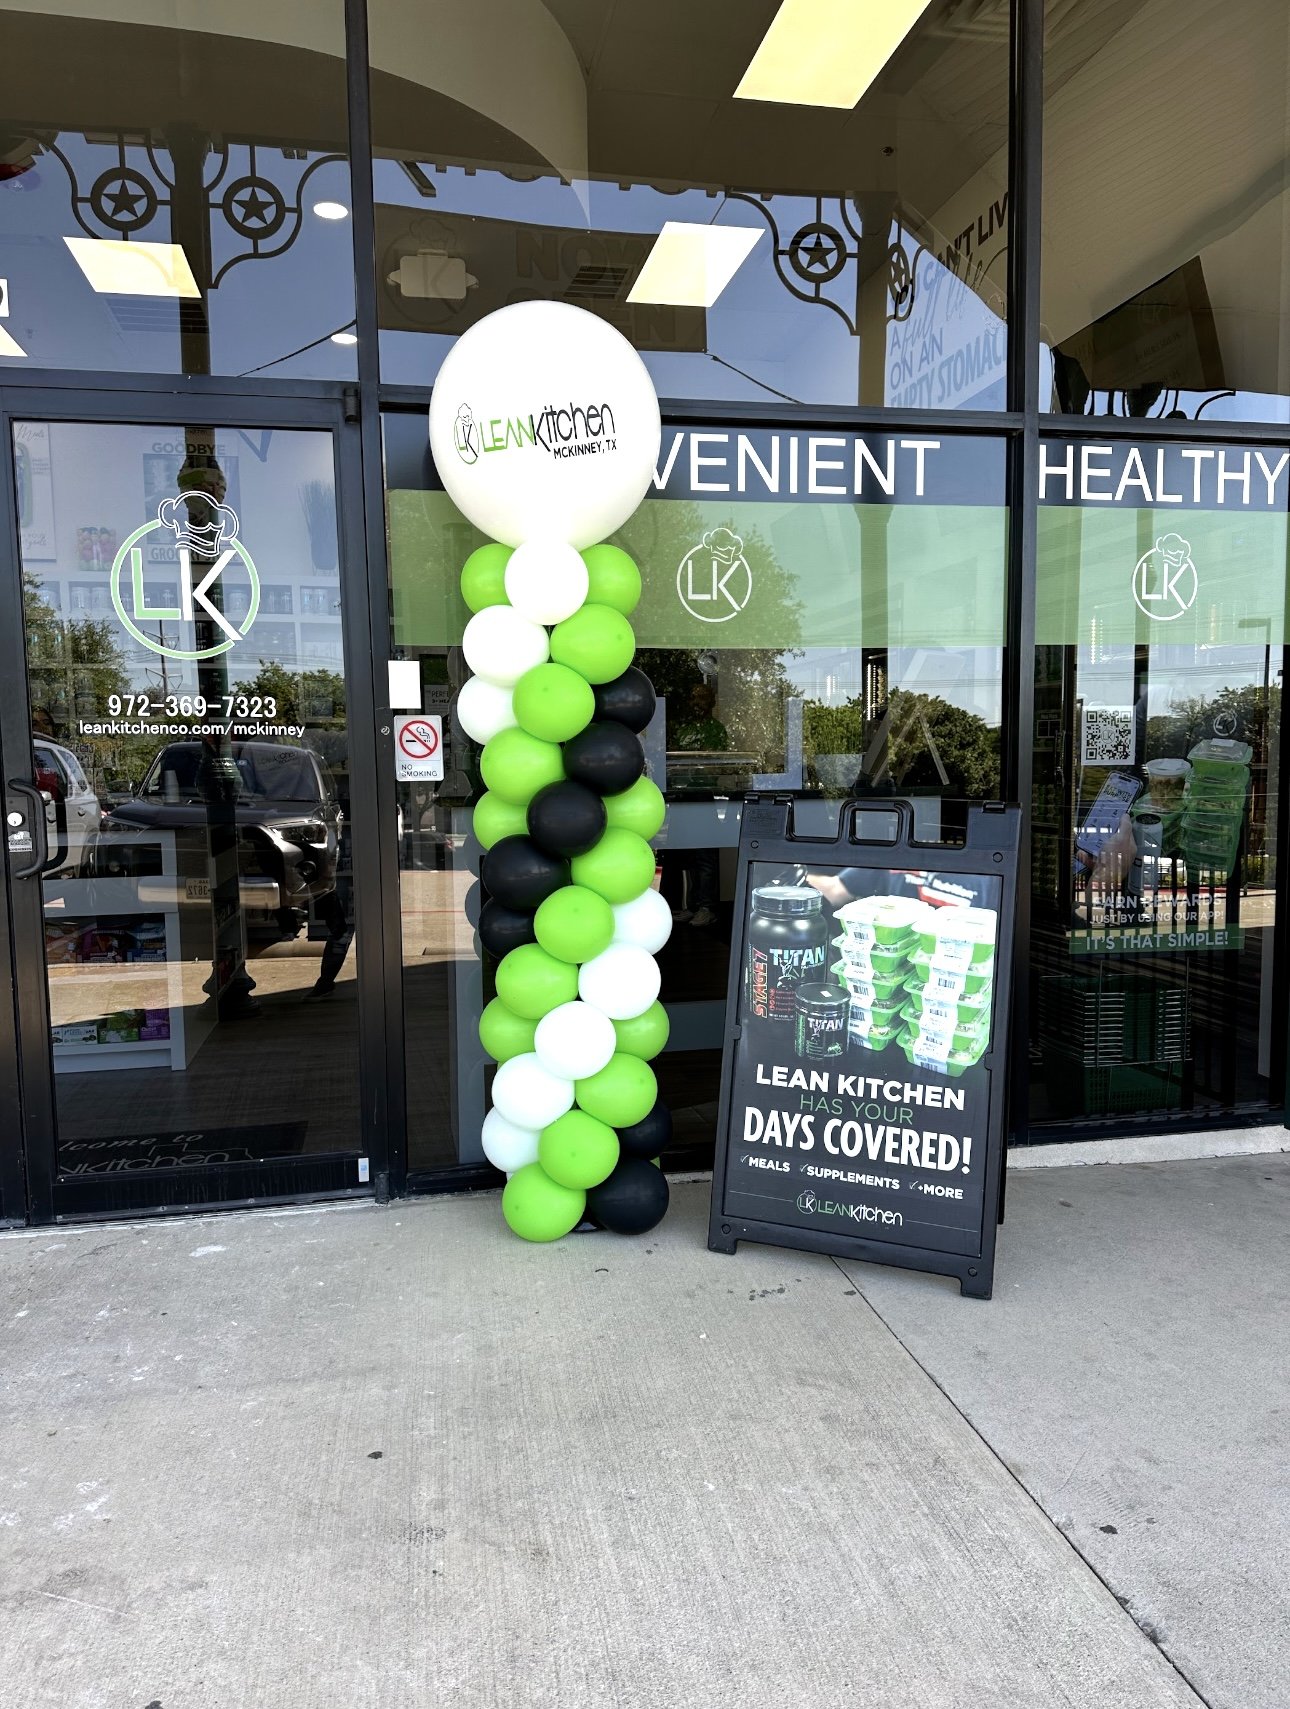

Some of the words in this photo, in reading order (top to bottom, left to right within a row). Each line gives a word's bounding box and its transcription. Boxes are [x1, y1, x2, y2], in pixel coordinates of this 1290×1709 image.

[891, 351, 913, 391] ON
[918, 328, 943, 373] AN
[152, 442, 226, 454] GOODBYE
[606, 439, 617, 450] TX
[1038, 444, 1290, 504] HEALTHY
[130, 547, 244, 641] LK
[688, 560, 742, 611] LK
[1142, 563, 1189, 609] LK
[108, 694, 277, 718] 972-369-7323
[79, 720, 305, 738] leankitchenco.com/mckinney
[1092, 896, 1137, 909] EARN
[1143, 893, 1222, 908] REWARDS
[1089, 914, 1117, 924] JUST
[1120, 914, 1134, 923] BY
[1138, 912, 1171, 922] USING
[1174, 912, 1197, 921] OUR
[1200, 911, 1224, 920] APP!
[1086, 935, 1116, 950] IT'S
[1122, 933, 1164, 949] THAT
[1168, 931, 1229, 947] SIMPLE!
[769, 946, 825, 966] TITAN
[807, 1018, 844, 1031] TITAN
[756, 1063, 829, 1092] LEAN
[837, 1074, 965, 1111] KITCHEN
[800, 1094, 843, 1114] HAS
[851, 1100, 913, 1125] YOUR
[172, 1134, 204, 1143] to
[743, 1106, 815, 1150] DAYS
[823, 1118, 972, 1174] COVERED!
[749, 1156, 790, 1172] MEALS
[806, 1165, 900, 1190] SUPPLEMENTS
